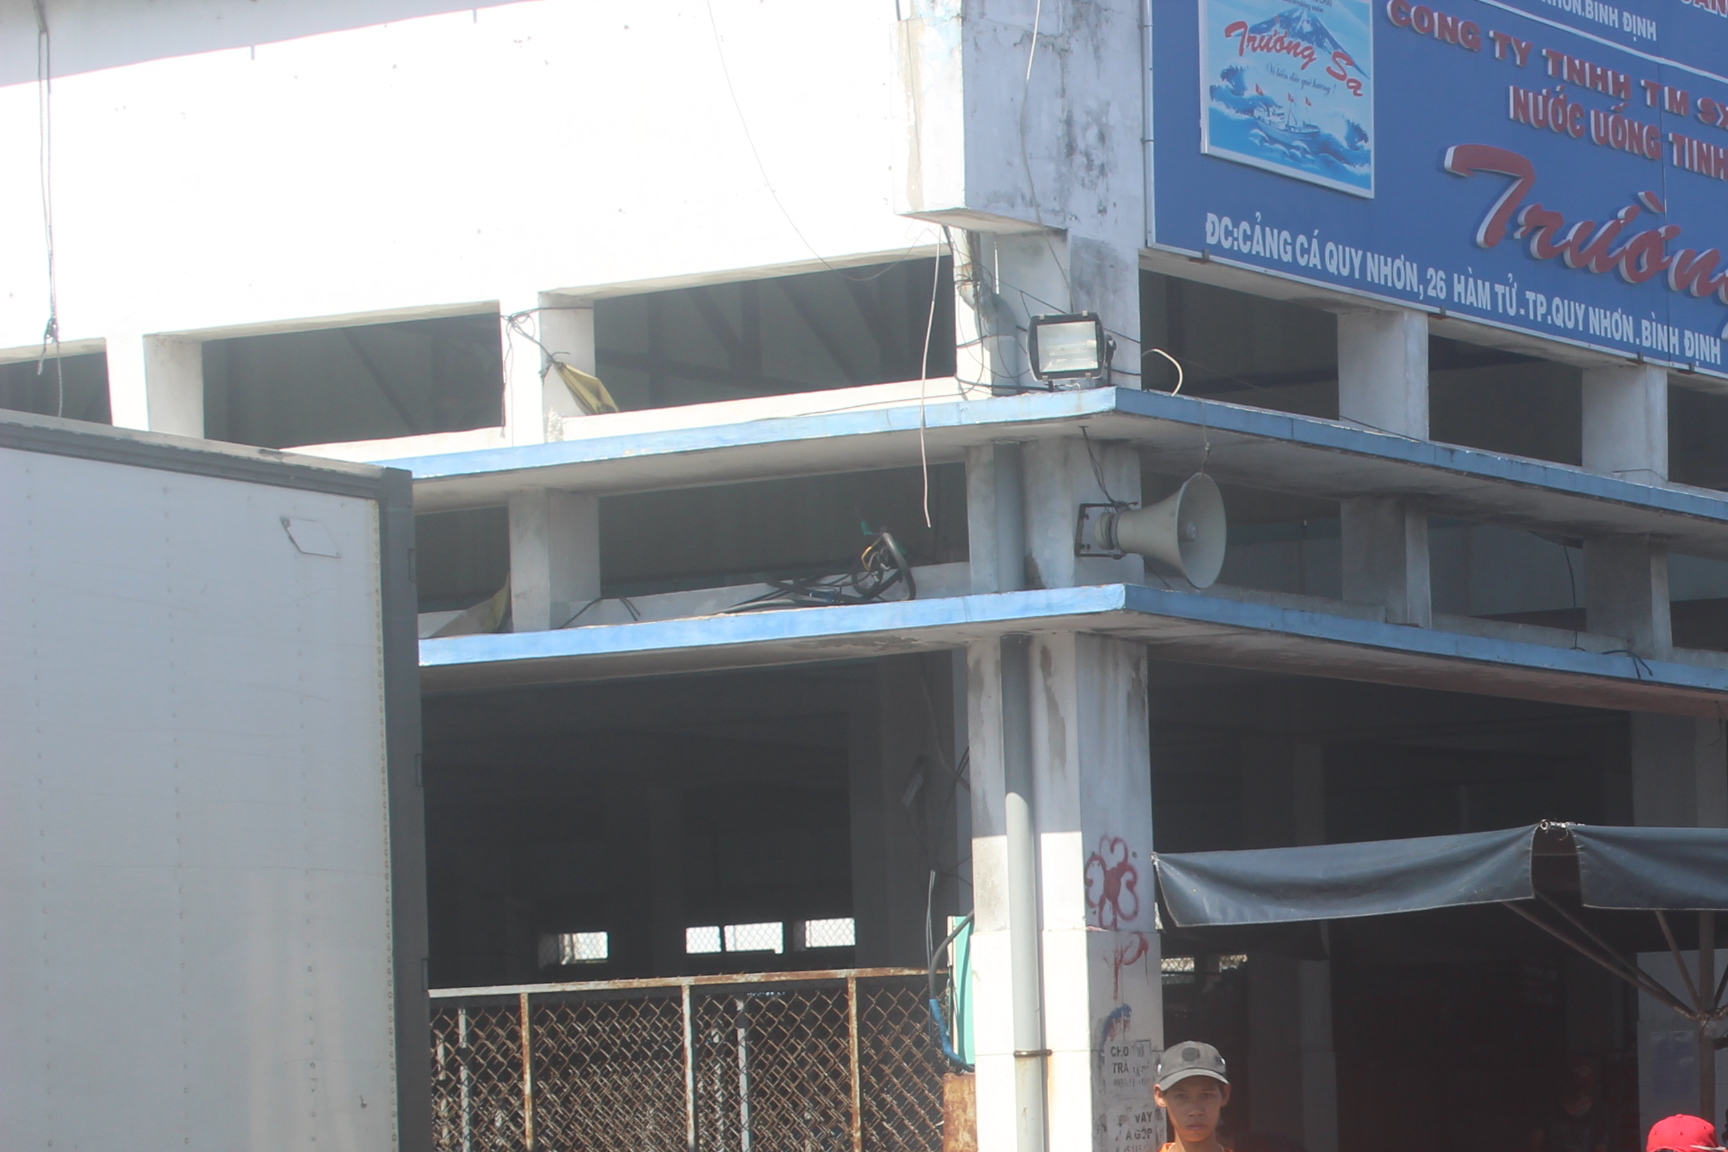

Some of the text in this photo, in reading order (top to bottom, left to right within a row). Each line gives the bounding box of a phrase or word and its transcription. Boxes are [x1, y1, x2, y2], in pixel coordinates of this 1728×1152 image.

[1622, 11, 1657, 42] ĐỊNH
[1326, 51, 1363, 97] Sa
[1489, 30, 1533, 67] TY
[1542, 48, 1632, 100] TNHH
[1509, 84, 1586, 139] NƯỚC
[1590, 102, 1662, 160] UỐNG
[1295, 229, 1322, 270] CÁ
[1324, 242, 1363, 279] QUY
[1366, 253, 1424, 300] NHƠN,
[1426, 268, 1447, 300] 26
[1453, 268, 1492, 312] HÀM
[1684, 329, 1721, 367] ĐỊNH
